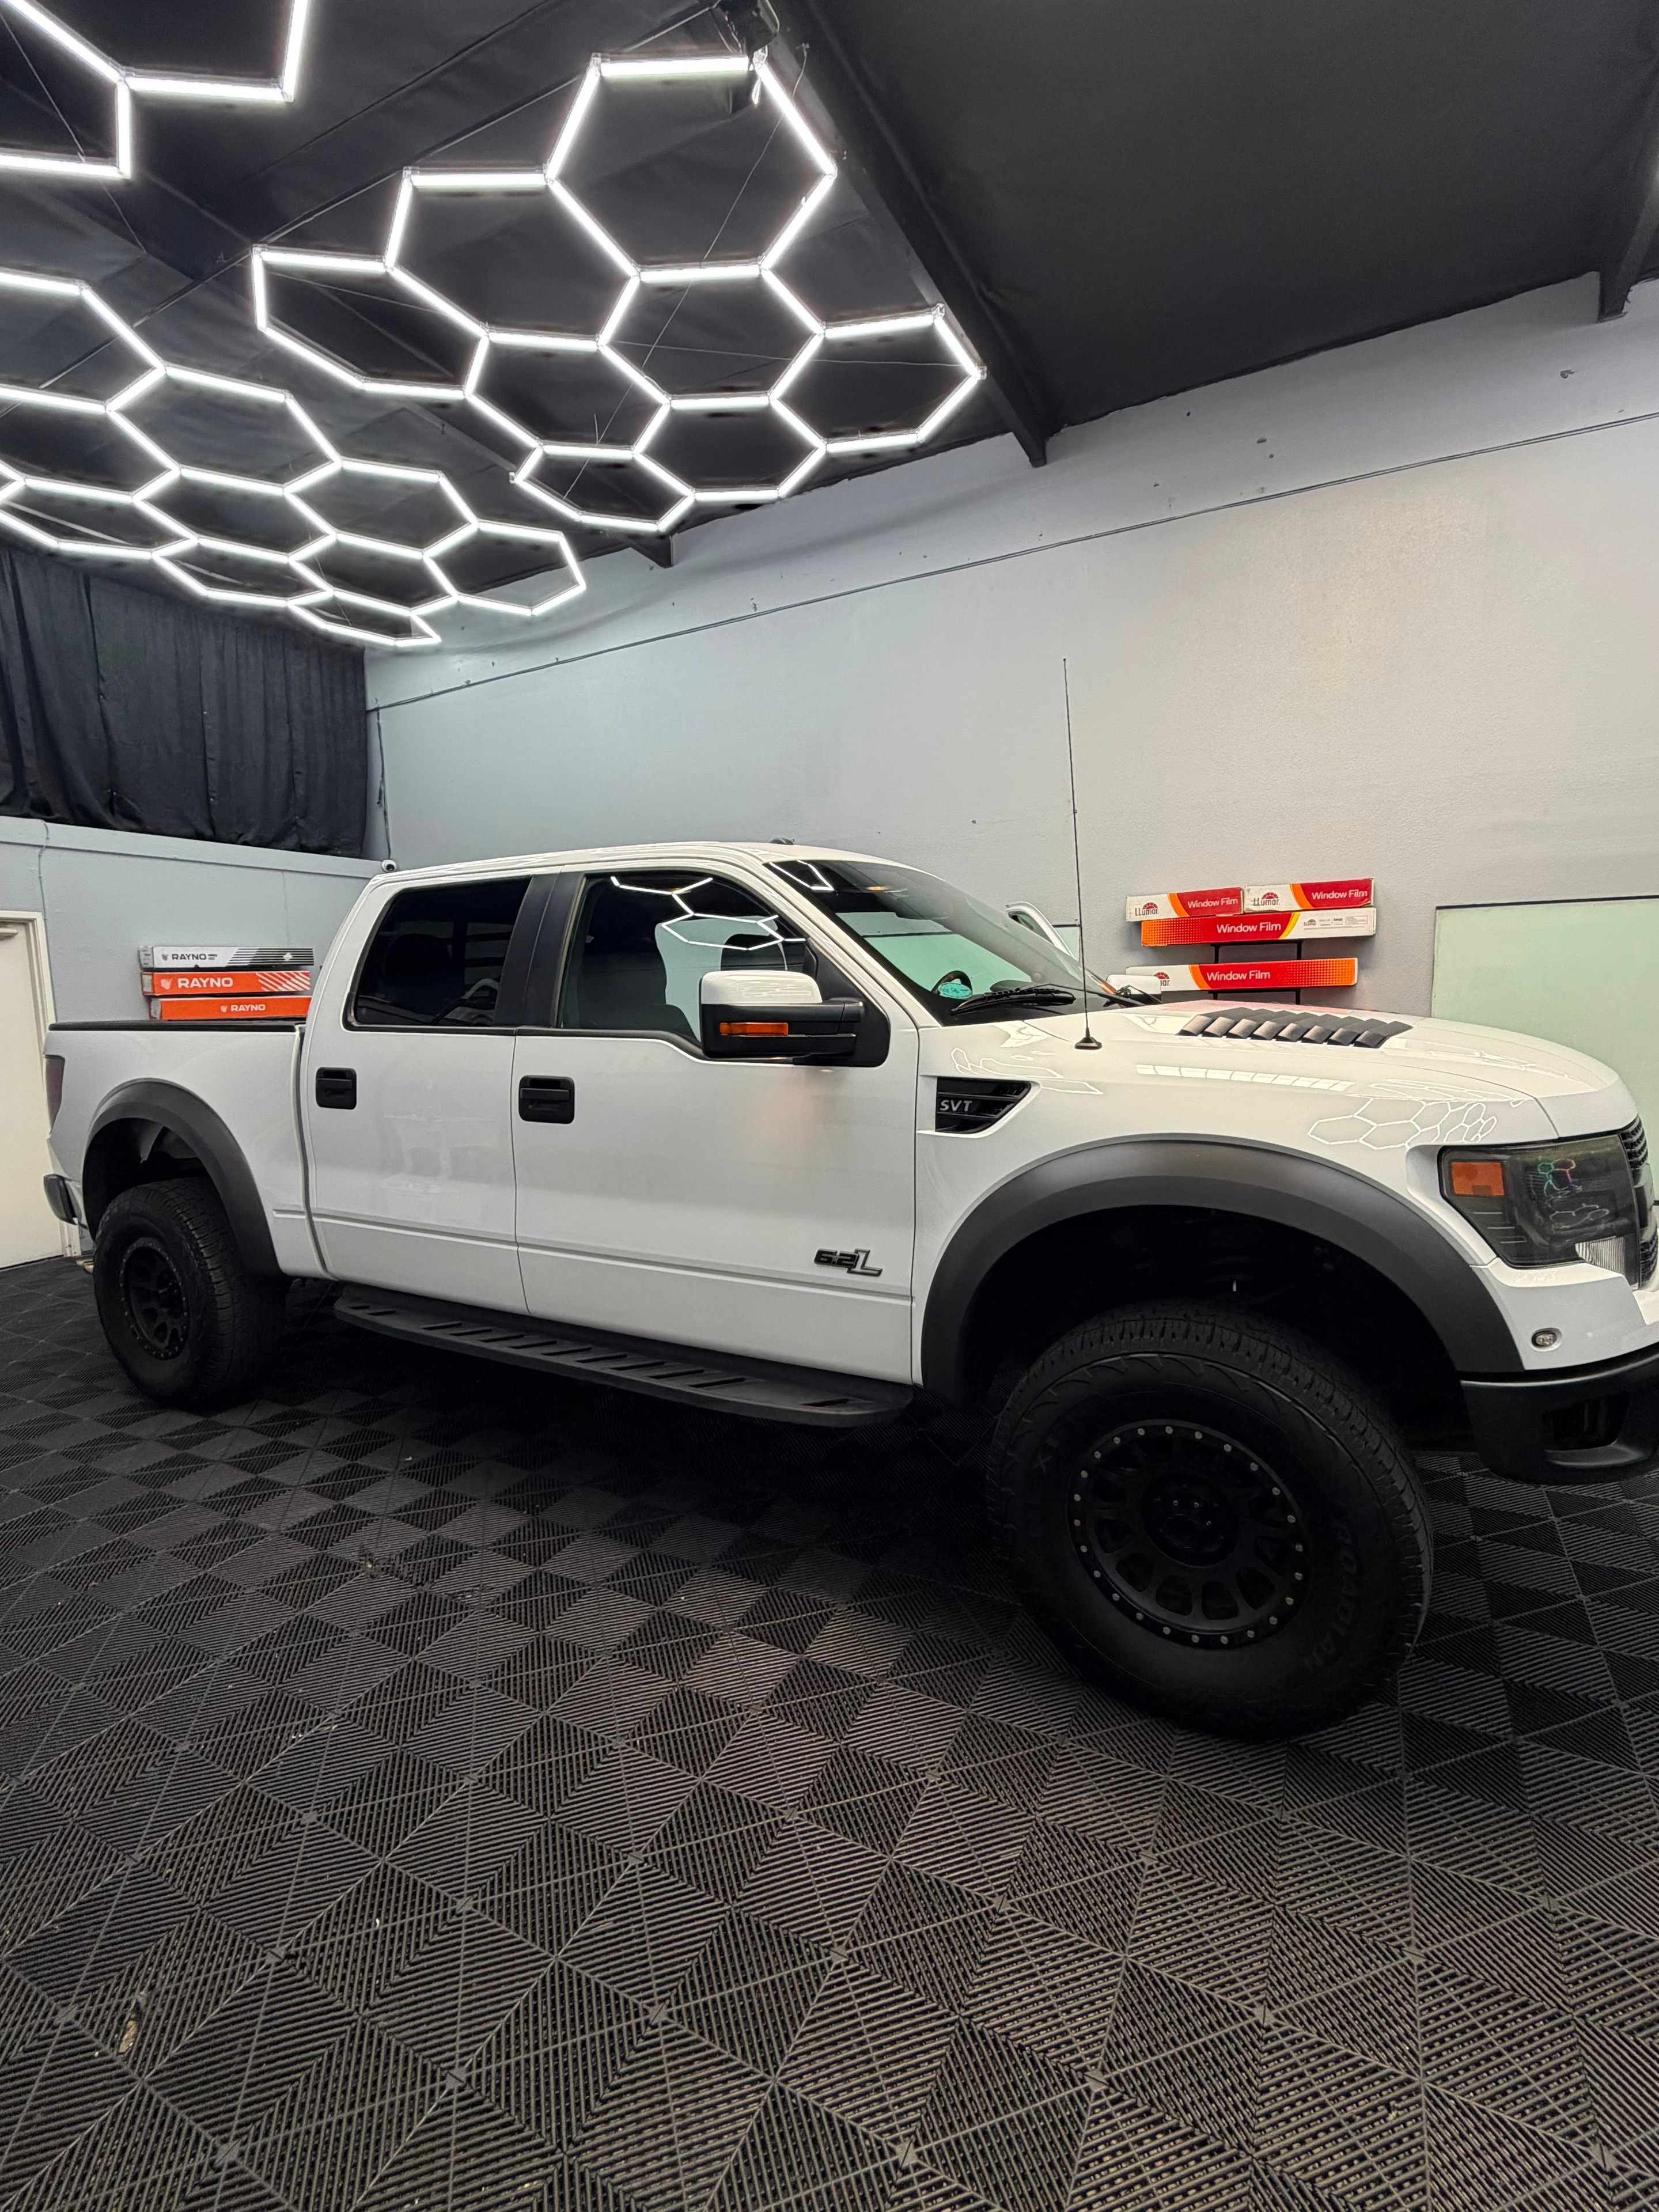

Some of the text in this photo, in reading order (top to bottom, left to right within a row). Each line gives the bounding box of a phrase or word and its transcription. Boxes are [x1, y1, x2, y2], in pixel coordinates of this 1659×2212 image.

[1312, 889, 1368, 900] Window Film
[1187, 897, 1238, 908] Window Film
[1217, 922, 1281, 933] Window Film
[1206, 970, 1271, 981] Window Film
[177, 977, 234, 988] RAYNO
[230, 1004, 266, 1012] RAYNO
[939, 1100, 972, 1112] SVT
